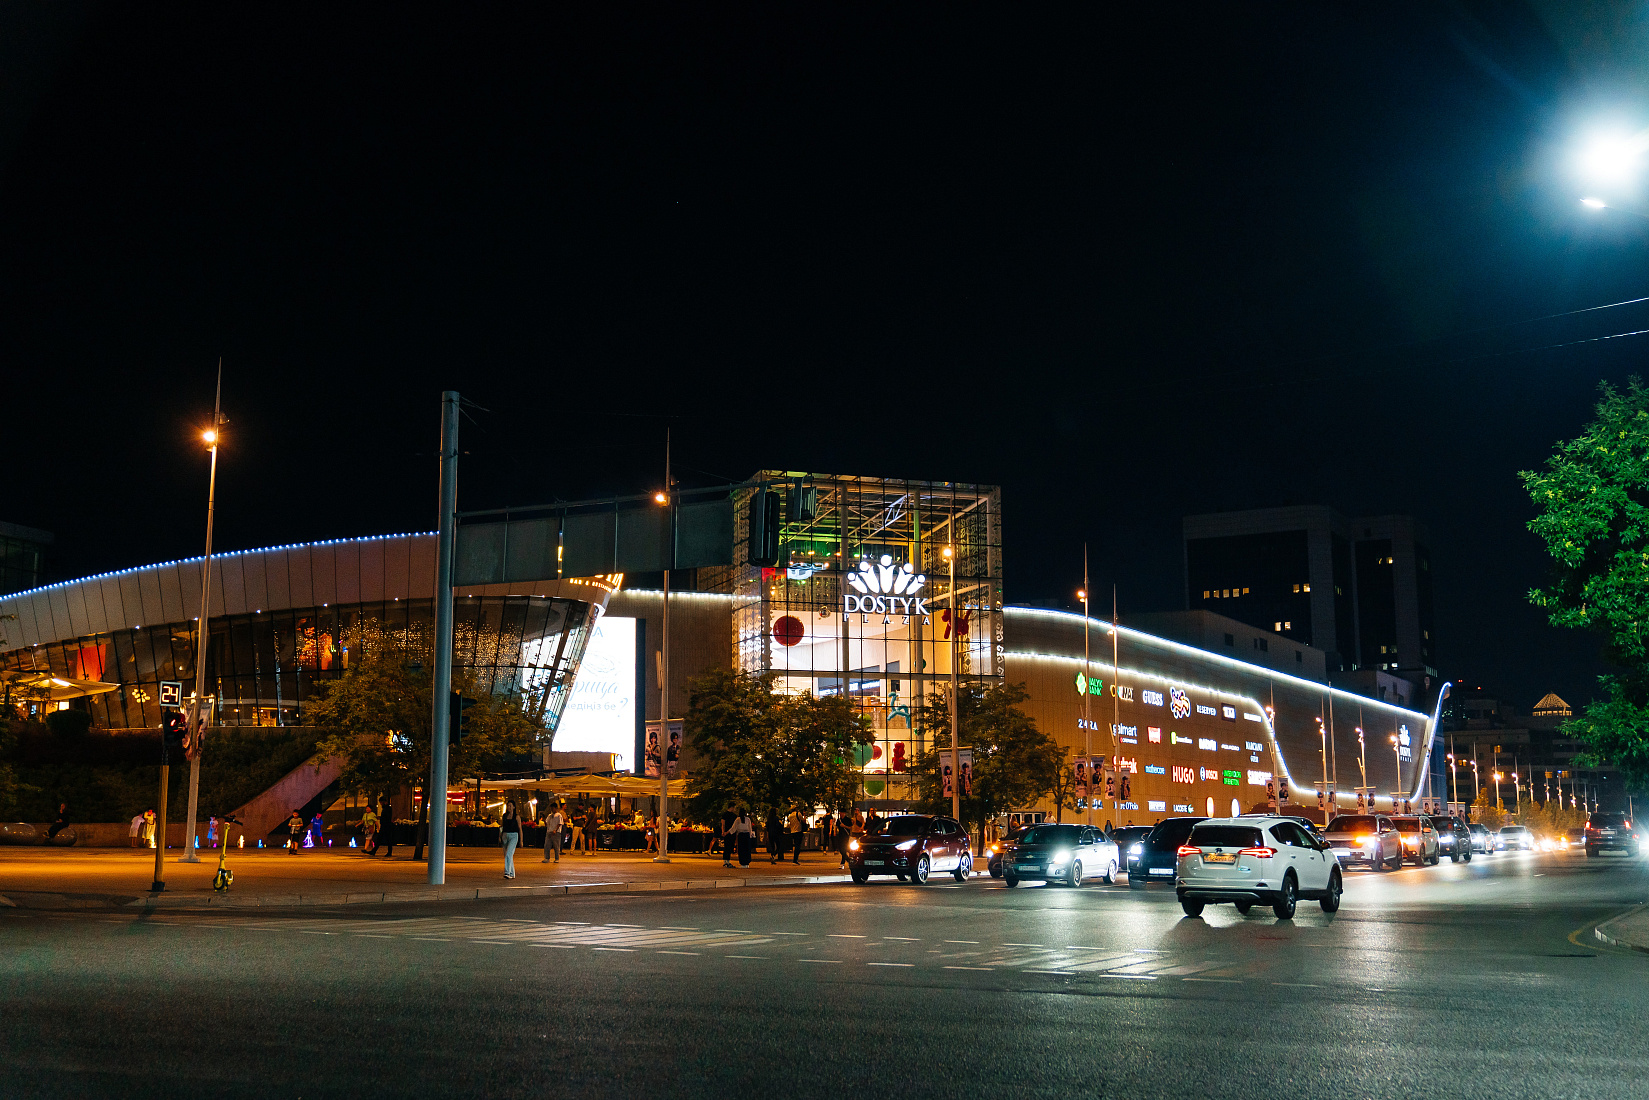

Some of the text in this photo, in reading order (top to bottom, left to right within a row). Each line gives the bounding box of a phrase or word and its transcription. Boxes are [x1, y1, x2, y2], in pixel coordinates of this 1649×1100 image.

[842, 594, 930, 615] DOSTYK
[842, 613, 930, 625] PLAZA
[162, 686, 178, 702] 24
[1142, 690, 1164, 706] GUESS
[1172, 765, 1194, 784] HUGO
[1206, 769, 1218, 780] BOSCH
